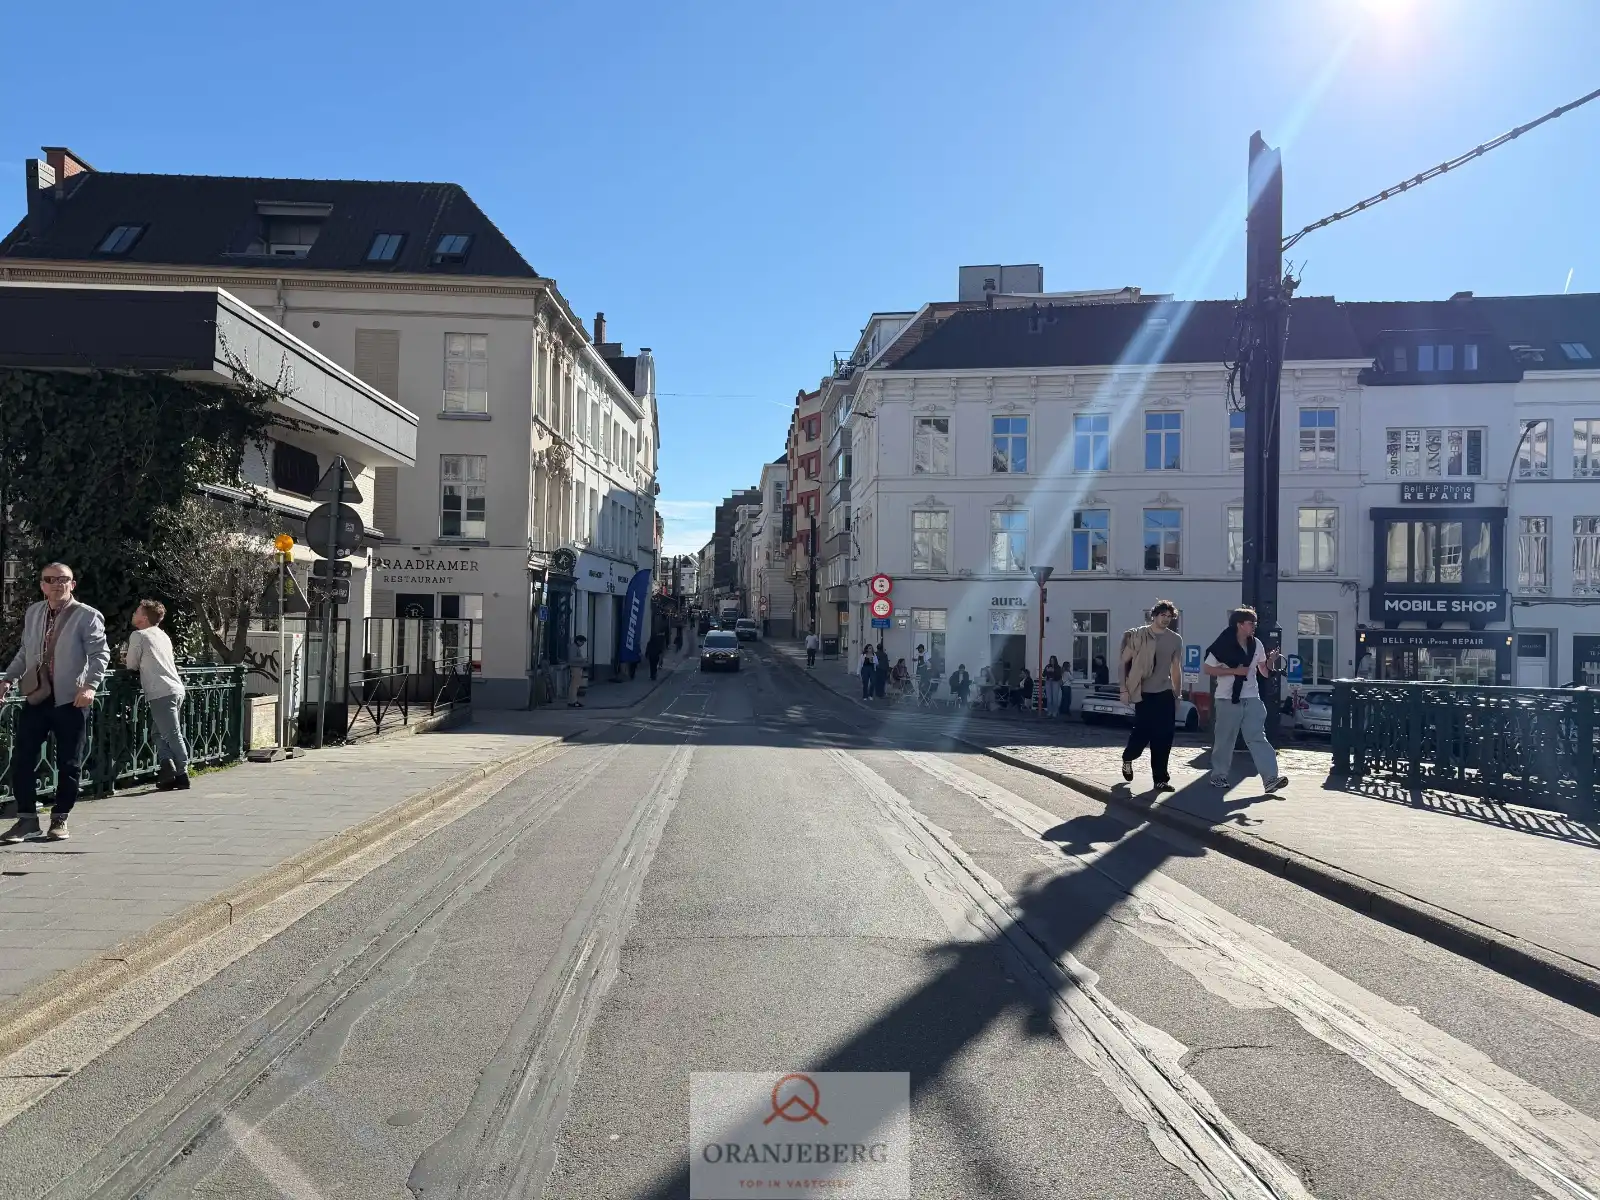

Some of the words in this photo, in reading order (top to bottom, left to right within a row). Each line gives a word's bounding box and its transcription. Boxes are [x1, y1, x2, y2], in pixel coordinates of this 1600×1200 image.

[1427, 435, 1440, 473] SONY
[1404, 485, 1420, 493] Bell
[1425, 485, 1439, 493] Fix
[1443, 485, 1472, 493] Phone
[1404, 492, 1472, 500] REPAIR
[383, 559, 479, 571] RAADKAMER
[383, 575, 454, 584] RESTAURANT
[991, 596, 1027, 607] aura.
[1384, 600, 1448, 612] MOBILE
[1451, 600, 1497, 613] SHOP
[625, 590, 641, 652] GIANT
[1188, 648, 1199, 663] P
[1289, 657, 1300, 673] P
